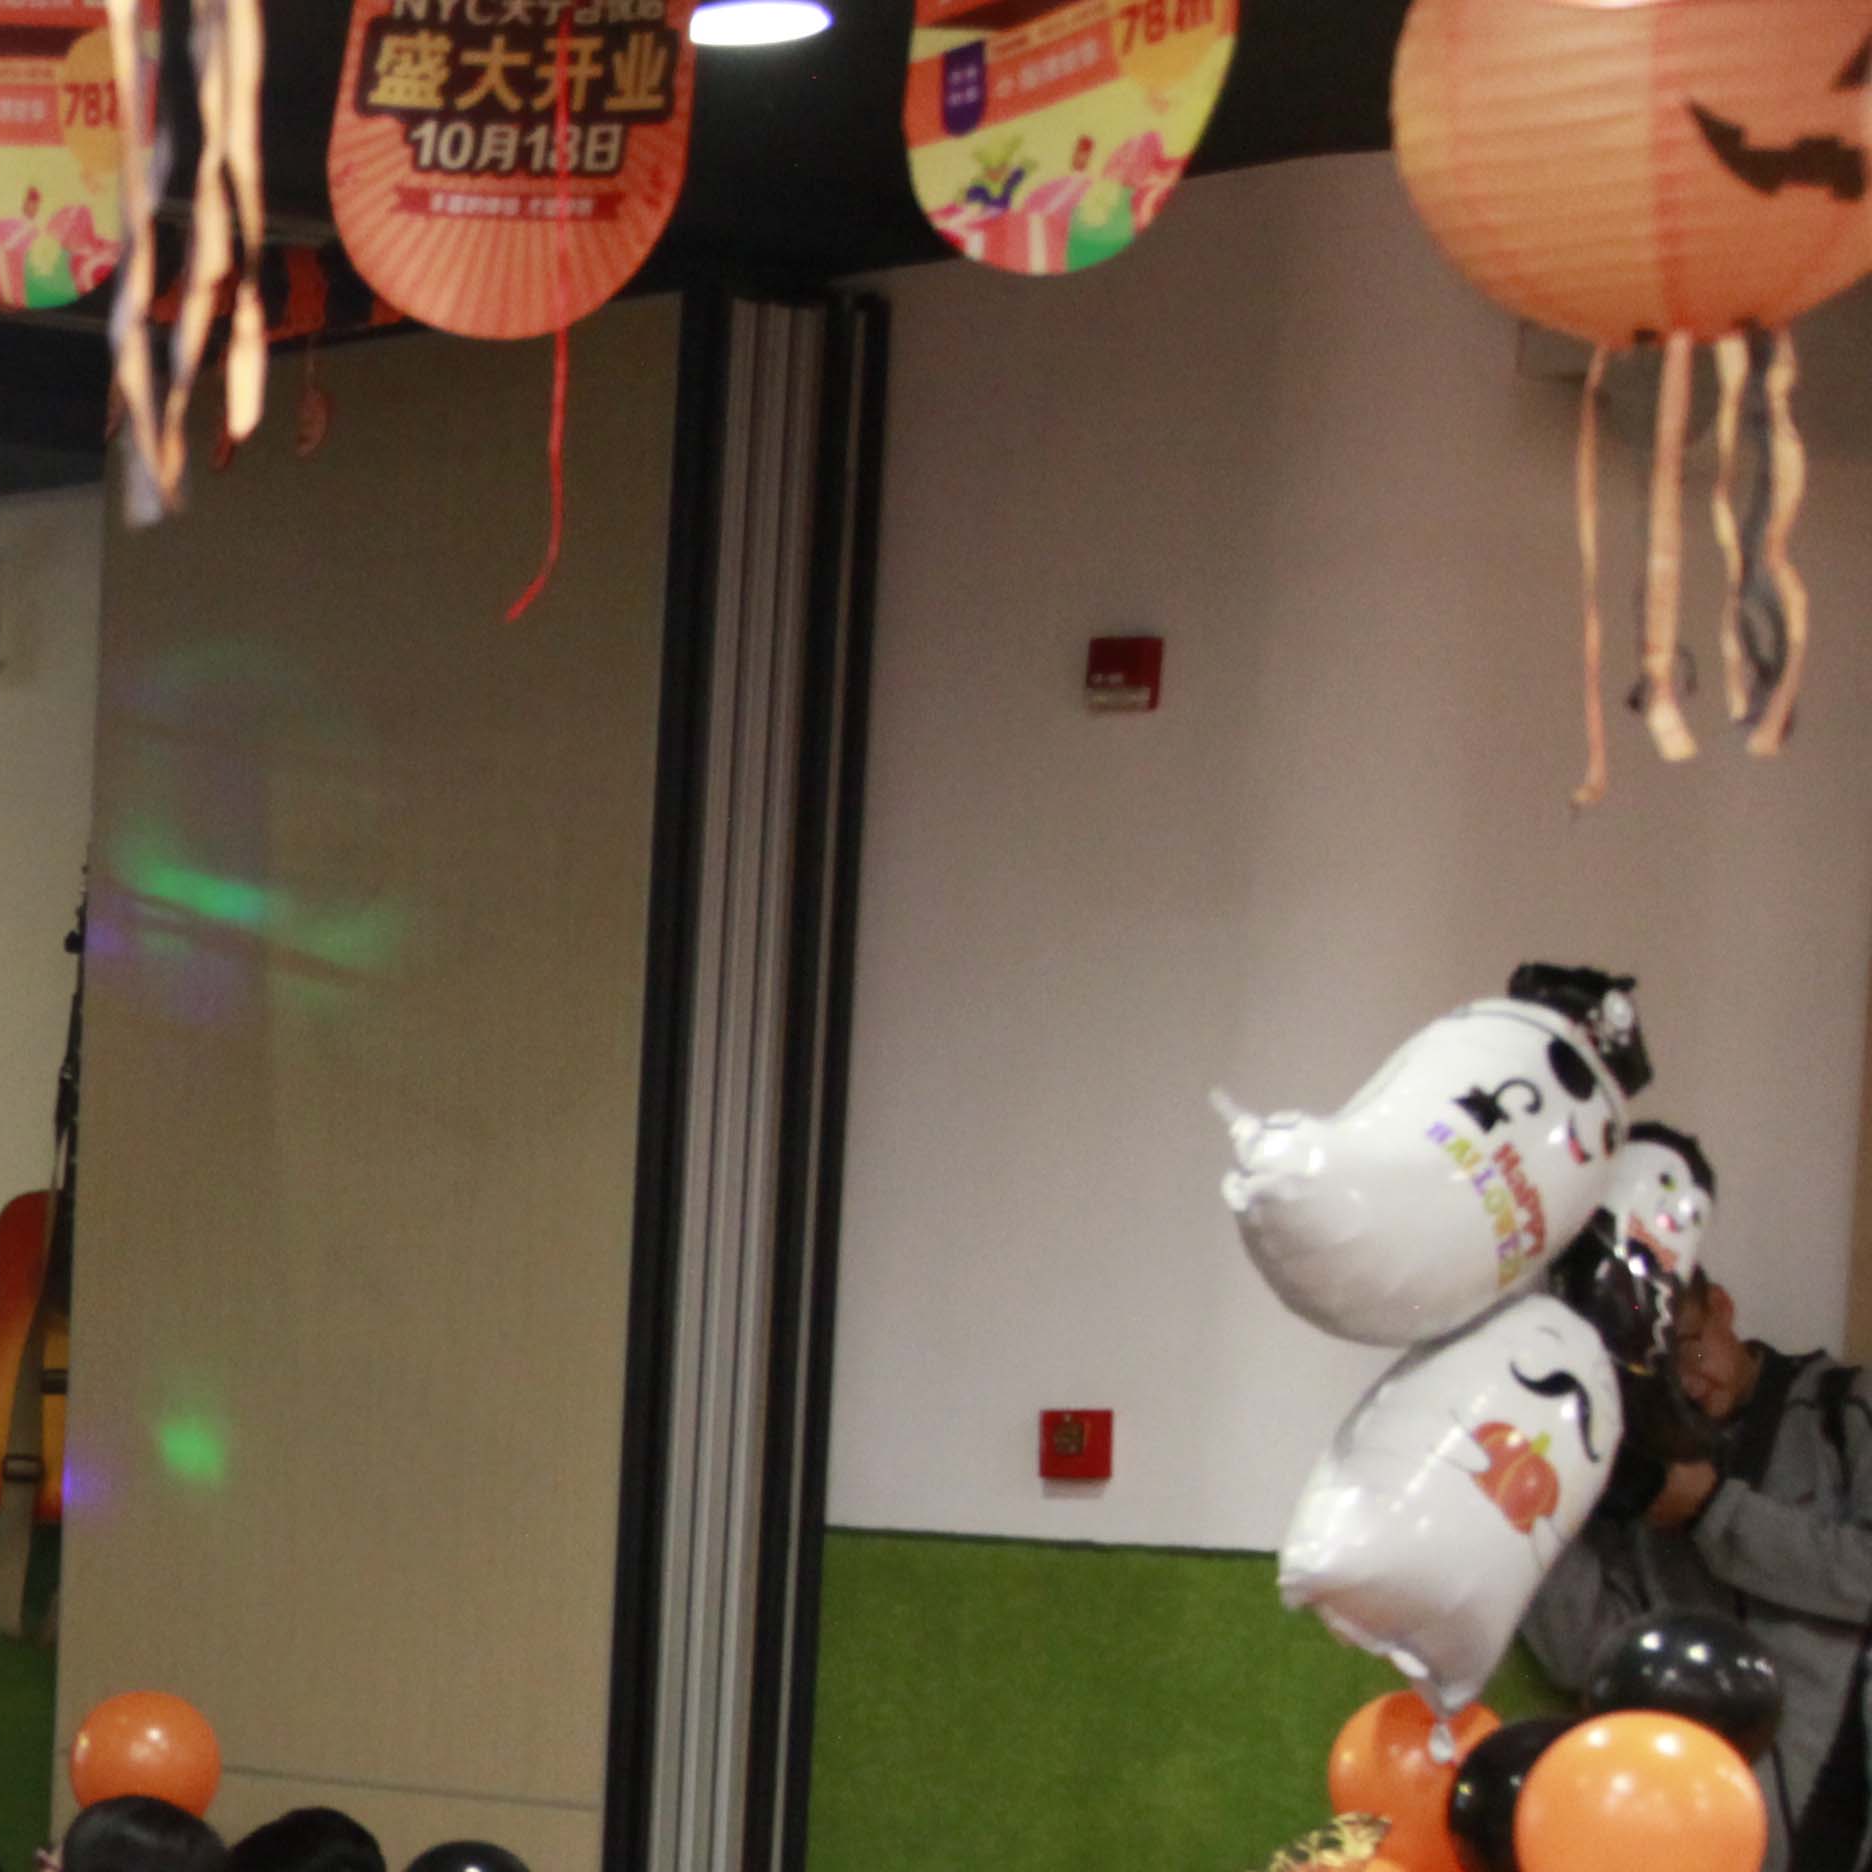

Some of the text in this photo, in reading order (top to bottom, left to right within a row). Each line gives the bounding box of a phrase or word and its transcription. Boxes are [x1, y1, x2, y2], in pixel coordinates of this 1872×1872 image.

[367, 29, 667, 112] 盛大开业
[410, 119, 624, 172] 10月18日
